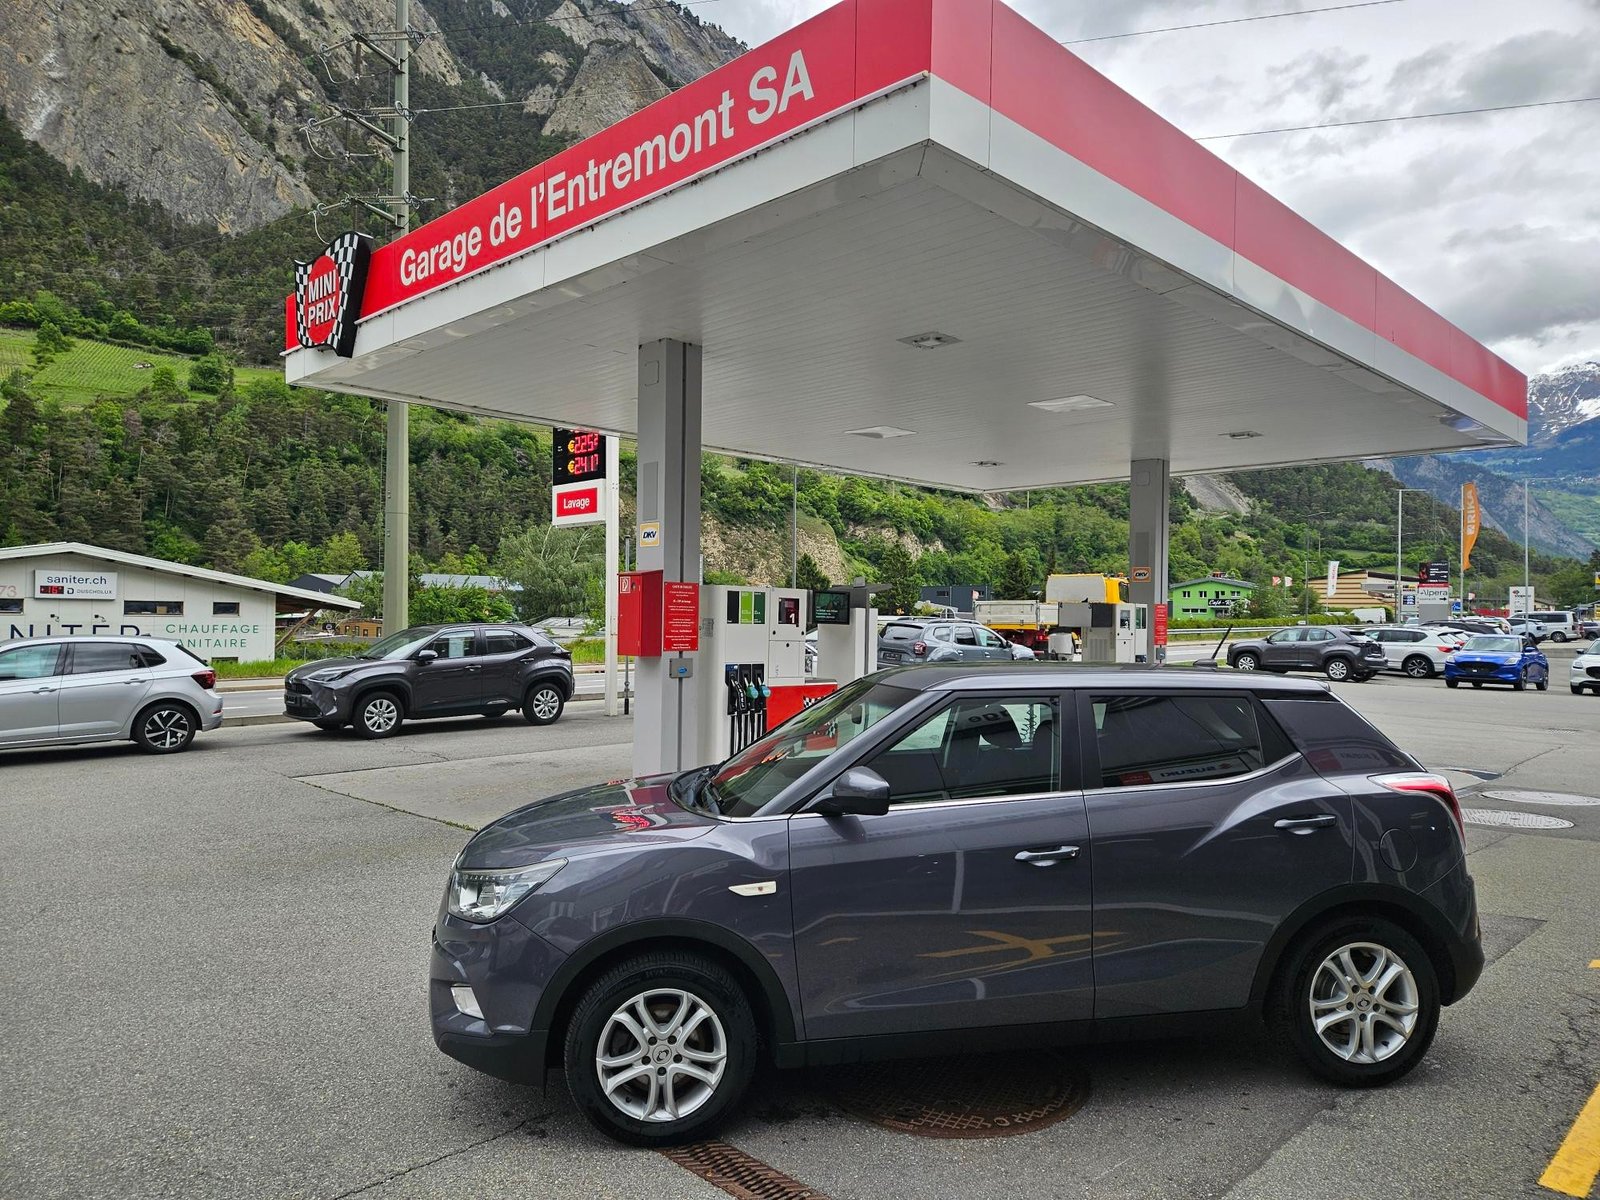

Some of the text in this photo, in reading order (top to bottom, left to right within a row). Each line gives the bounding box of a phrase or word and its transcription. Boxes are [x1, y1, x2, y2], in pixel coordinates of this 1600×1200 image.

[400, 49, 815, 286] Garage de l'Entremont SA
[308, 269, 336, 303] MINI
[308, 296, 336, 328] PRIX
[563, 497, 590, 510] Lavage
[643, 530, 657, 539] DKV
[46, 575, 107, 585] saniter.ch
[789, 612, 795, 624] 1
[165, 624, 260, 634] CHAUFFAGE
[177, 638, 247, 648] ANITAIRE
